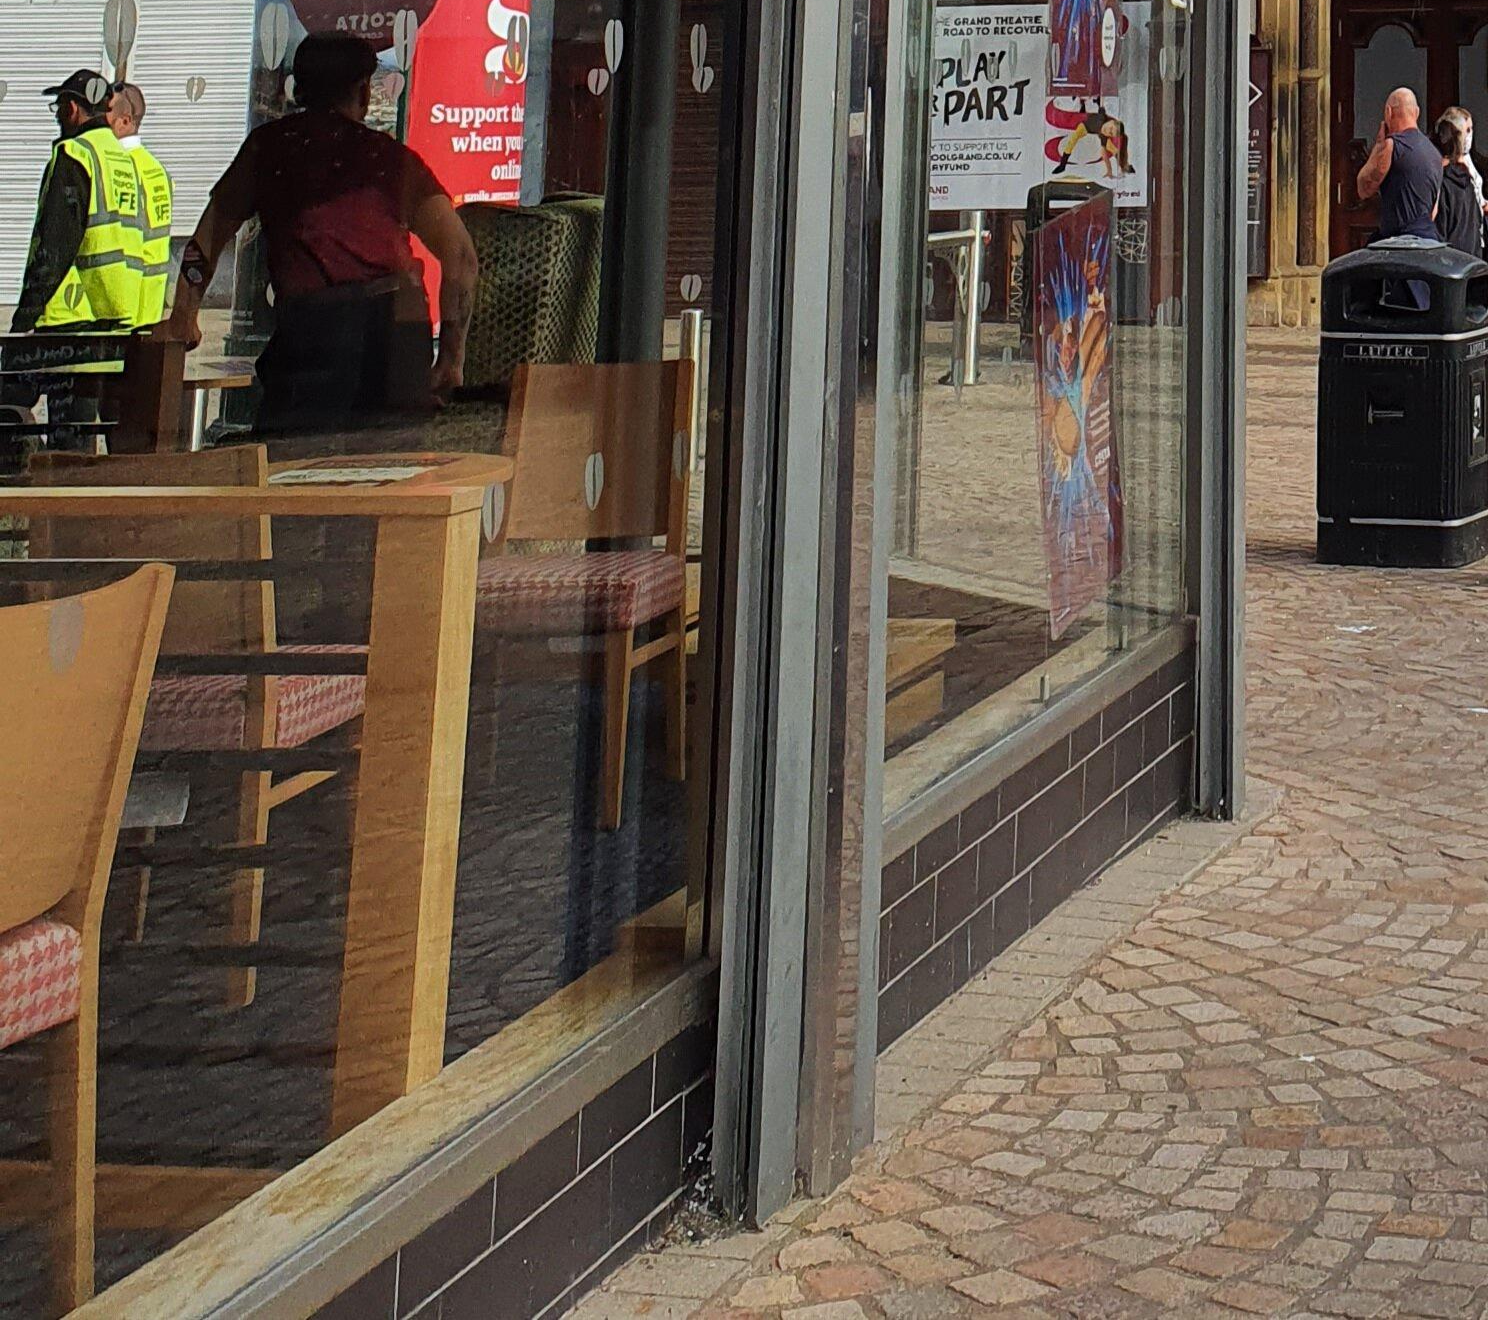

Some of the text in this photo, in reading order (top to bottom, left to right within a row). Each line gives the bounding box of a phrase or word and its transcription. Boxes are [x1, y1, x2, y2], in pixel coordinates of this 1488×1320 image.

[954, 16, 992, 26] GRAND
[994, 14, 1043, 24] THEATRE
[943, 27, 974, 36] ROAD
[976, 26, 990, 35] TO
[943, 78, 1031, 126] PART
[430, 103, 510, 129] Support
[451, 131, 503, 153] when
[953, 142, 992, 151] SUPPORT
[994, 142, 1008, 151] US
